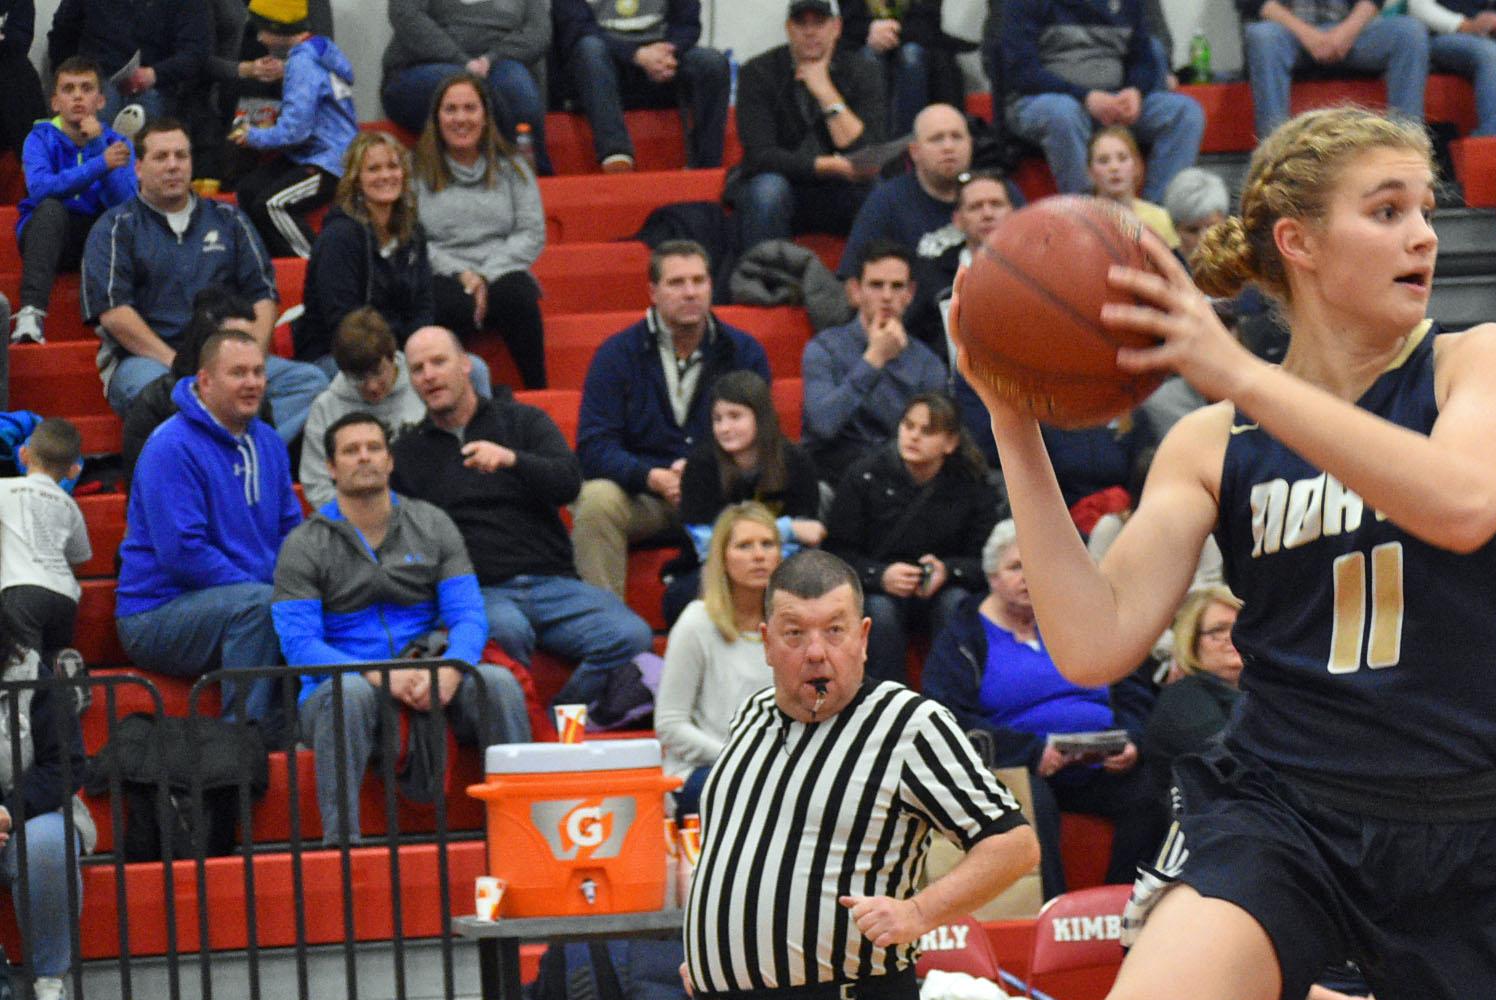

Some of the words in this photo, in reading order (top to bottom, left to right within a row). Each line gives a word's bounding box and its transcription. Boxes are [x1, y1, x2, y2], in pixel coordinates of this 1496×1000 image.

[1250, 470, 1386, 558] NOR
[1327, 540, 1404, 674] 11
[566, 805, 602, 847] G
[1052, 914, 1122, 942] KIMB
